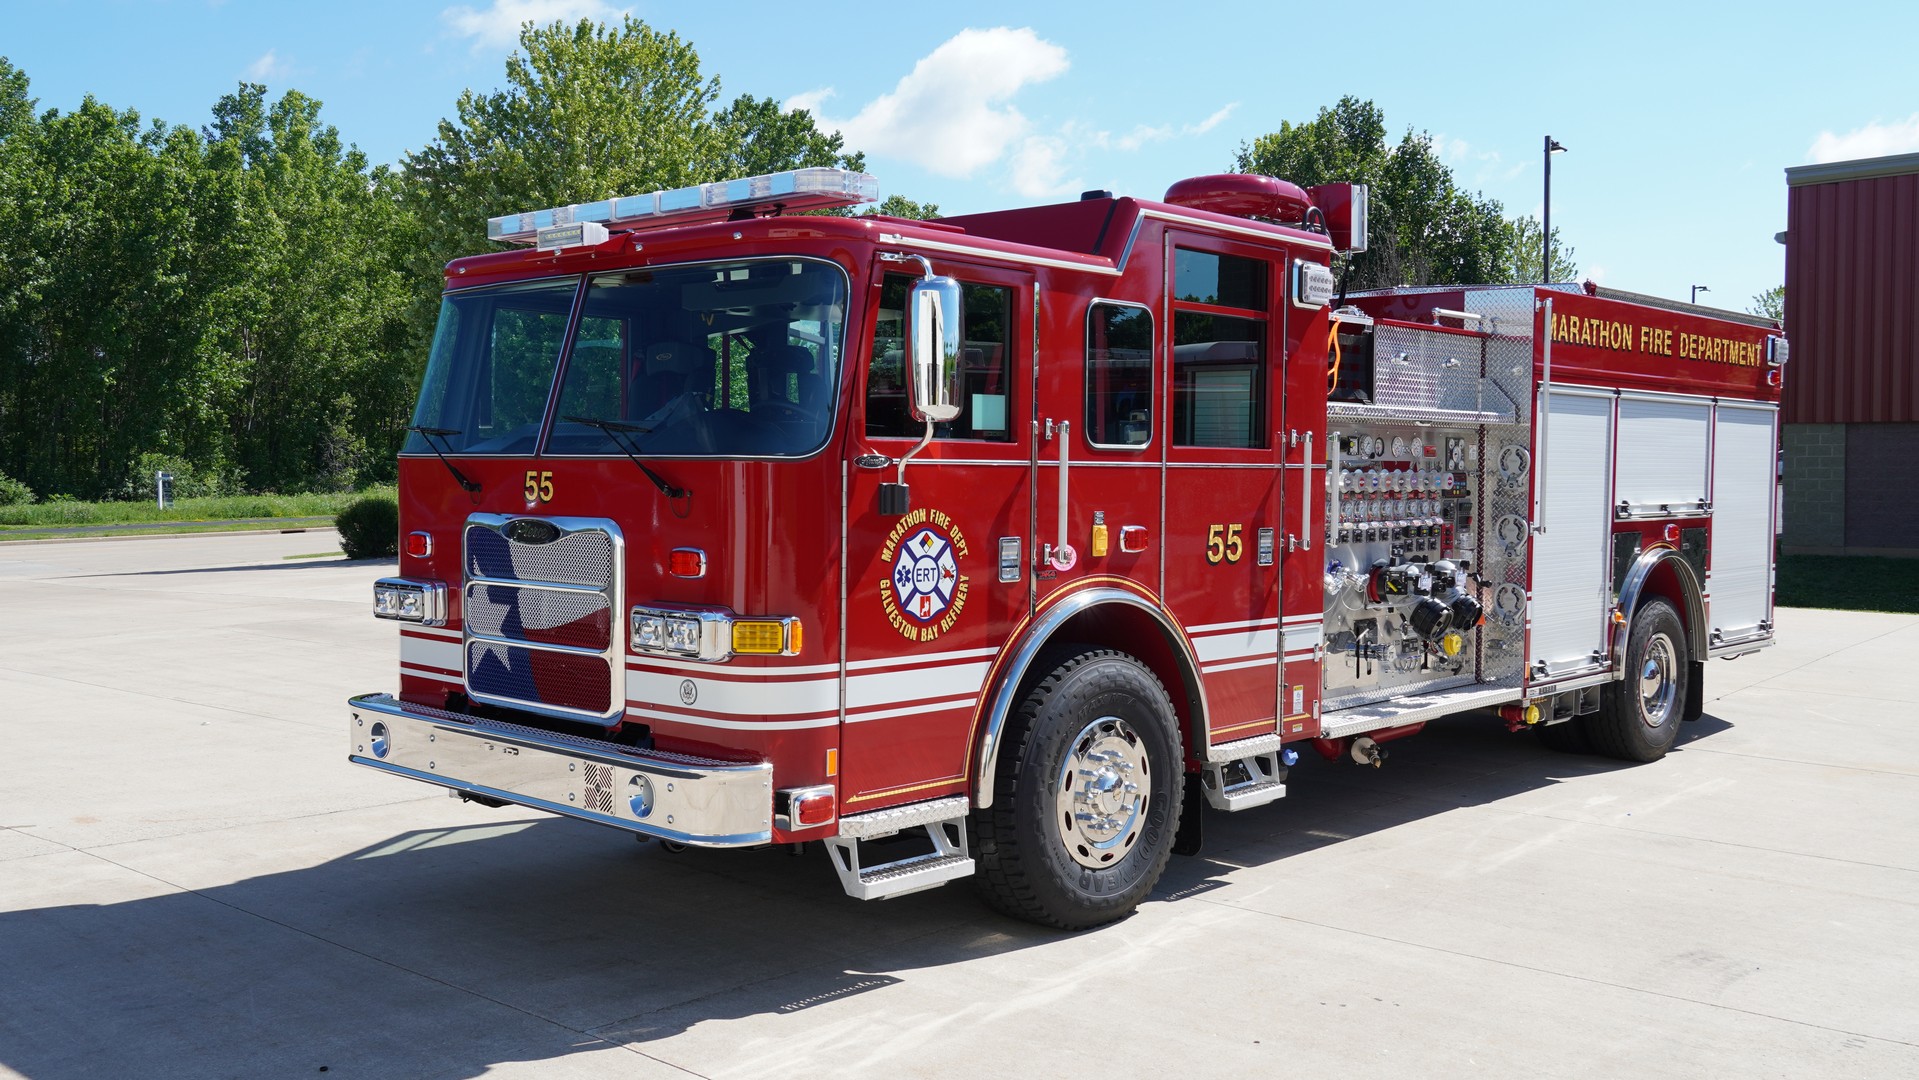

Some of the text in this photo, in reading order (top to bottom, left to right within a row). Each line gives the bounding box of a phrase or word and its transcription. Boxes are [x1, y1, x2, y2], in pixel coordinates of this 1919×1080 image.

[1640, 326, 1672, 356] FIRE
[1679, 332, 1762, 367] DEPARTMENT
[524, 470, 554, 503] 55
[881, 508, 968, 562] MARATHON FIRE DEPT.
[1206, 523, 1243, 565] 55
[916, 567, 937, 583] ERT
[880, 574, 970, 642] GALVESTON BAY REFINERY
